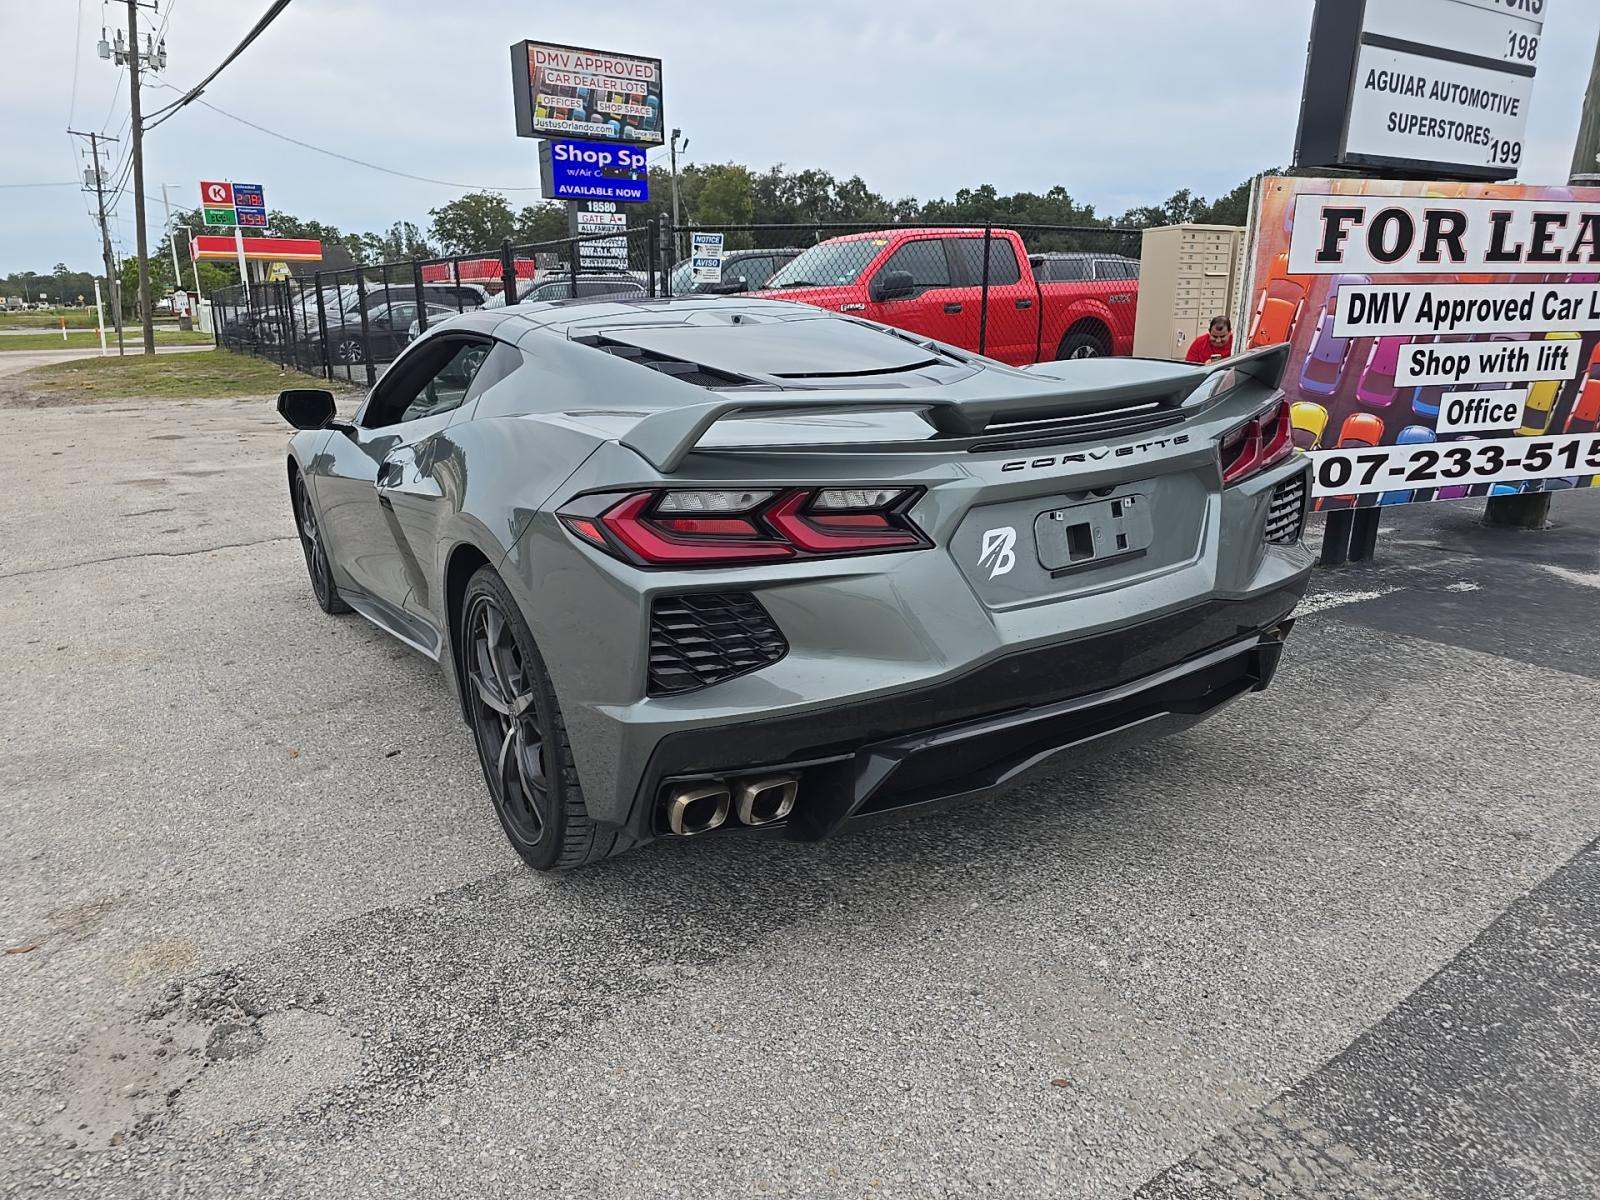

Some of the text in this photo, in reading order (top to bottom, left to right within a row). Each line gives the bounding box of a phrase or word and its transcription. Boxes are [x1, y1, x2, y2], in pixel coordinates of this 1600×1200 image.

[1508, 32, 1539, 62] 198
[536, 51, 653, 78] DMV APPROVED
[546, 72, 646, 94] CAR DEALER LOTS
[1365, 68, 1520, 117] AGUIAR AUTOMOTIVE
[543, 96, 581, 108] OFFICES
[599, 103, 651, 115] SHOP SPACE
[535, 119, 613, 134] JustusOrlando.com
[1387, 111, 1491, 146] SUPERSTORES
[554, 144, 612, 167] Shop
[1490, 139, 1522, 165] 199
[213, 188, 226, 201] K
[559, 185, 641, 198] AVAILABLE NOW
[587, 200, 617, 213] 18580
[582, 214, 617, 223] GATE A
[695, 236, 721, 244] NOTICE
[1315, 206, 1600, 264] FOR LEA
[695, 259, 719, 267] AVISO
[1347, 292, 1411, 325] DMV
[1415, 291, 1535, 331] Approved
[1541, 290, 1584, 321] Car
[1409, 345, 1569, 381] Shop with lift
[1446, 398, 1517, 426] Office
[1001, 434, 1190, 473] CORVETTE
